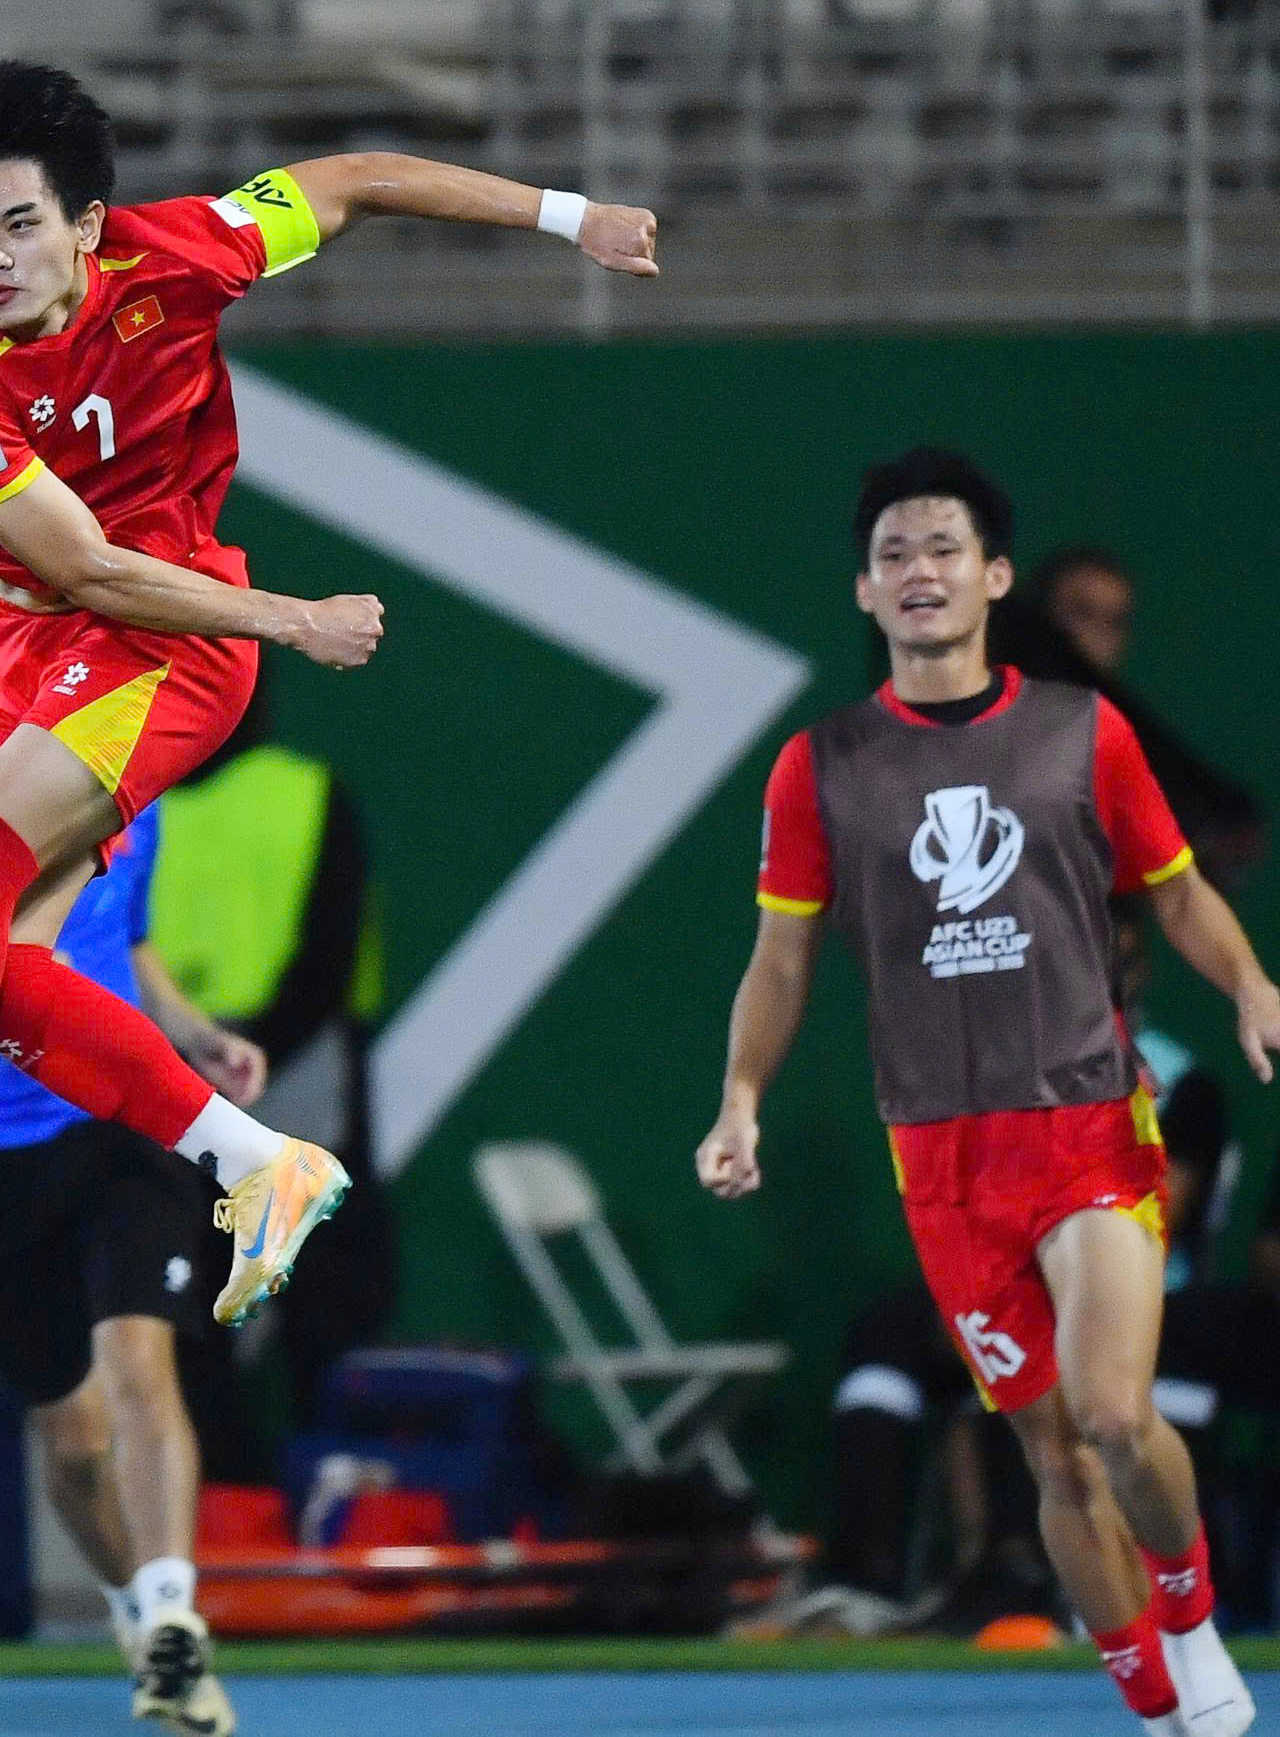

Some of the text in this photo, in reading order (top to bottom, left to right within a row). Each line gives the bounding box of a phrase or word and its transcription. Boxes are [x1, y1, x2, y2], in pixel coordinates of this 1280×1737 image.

[71, 393, 116, 461] 7
[930, 920, 974, 944] AFC
[985, 932, 1032, 957] CUP
[954, 1309, 1026, 1385] 15
